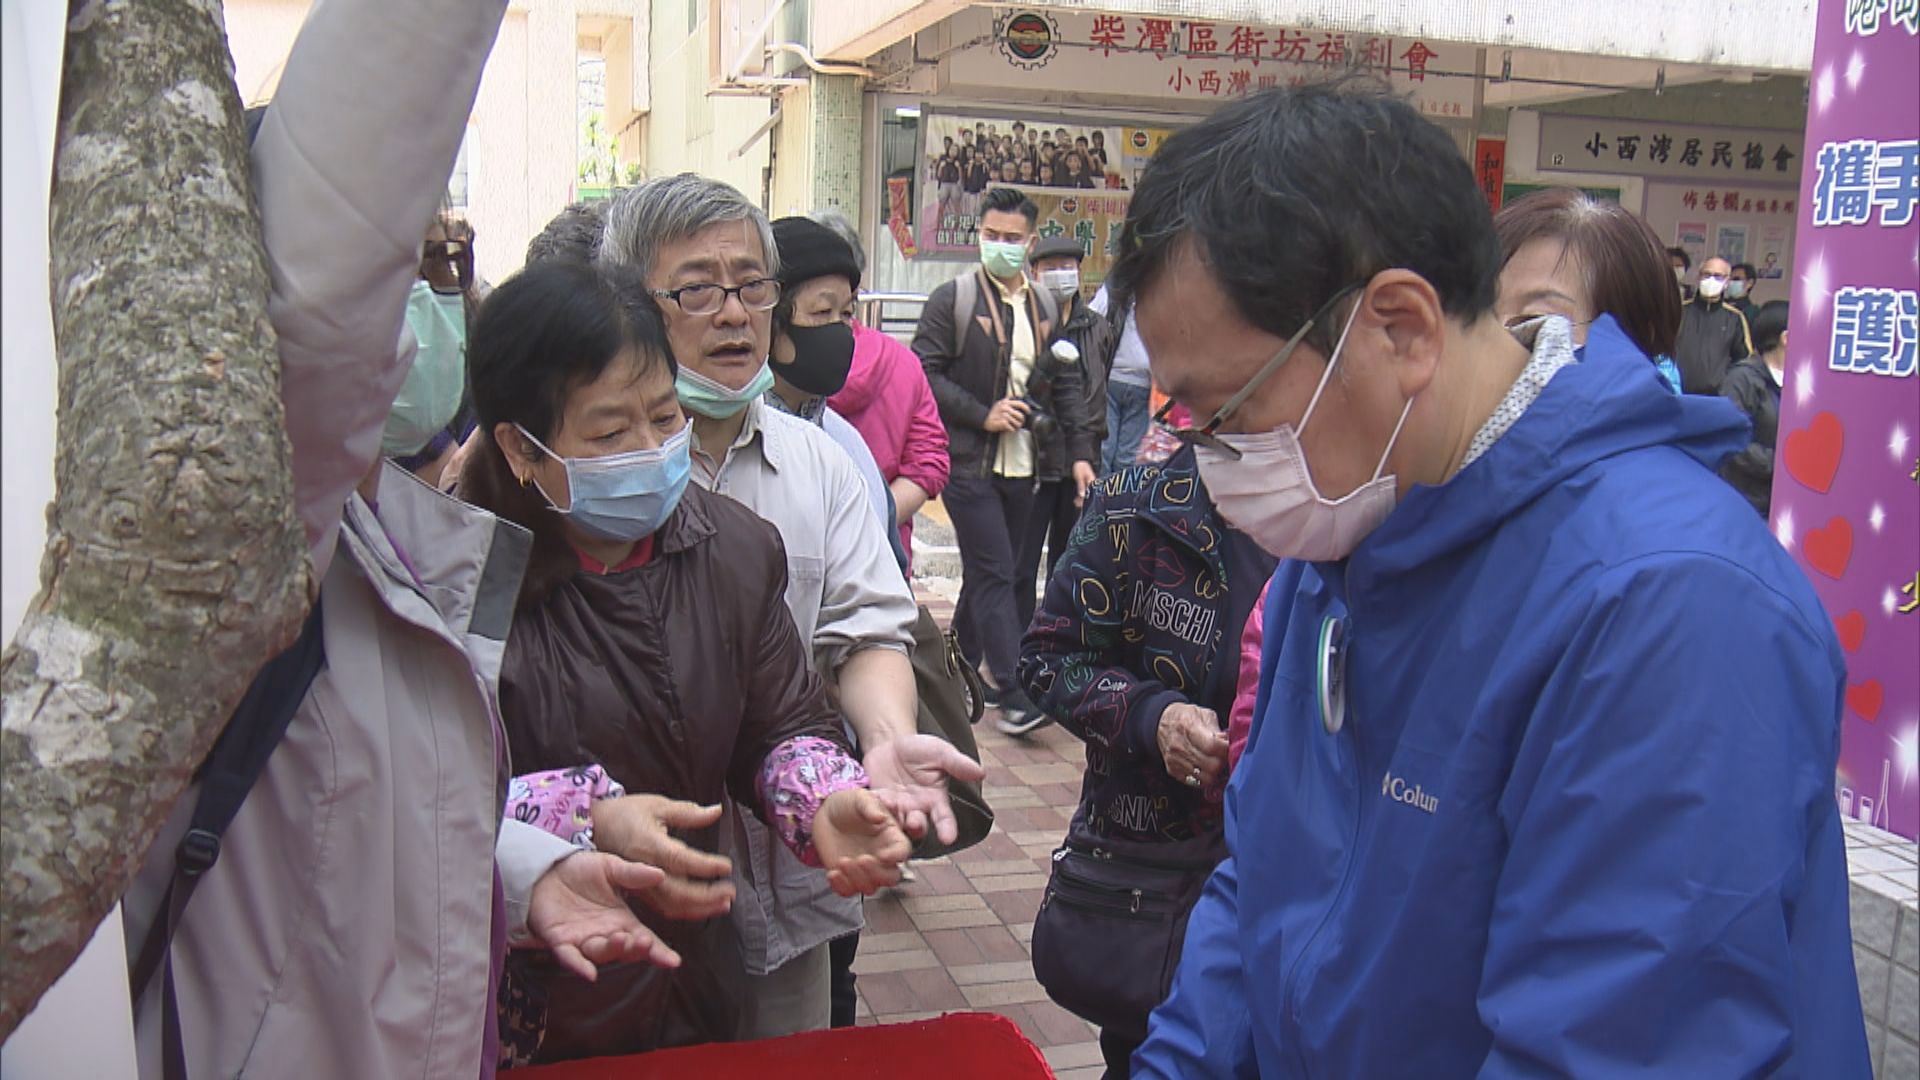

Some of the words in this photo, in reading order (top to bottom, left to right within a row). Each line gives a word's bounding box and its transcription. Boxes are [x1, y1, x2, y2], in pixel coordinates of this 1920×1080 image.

[1089, 14, 1438, 83] 柴灣區街坊福利會
[1585, 131, 1795, 172] 小西灣居民協會
[1812, 139, 1919, 226] 攜手
